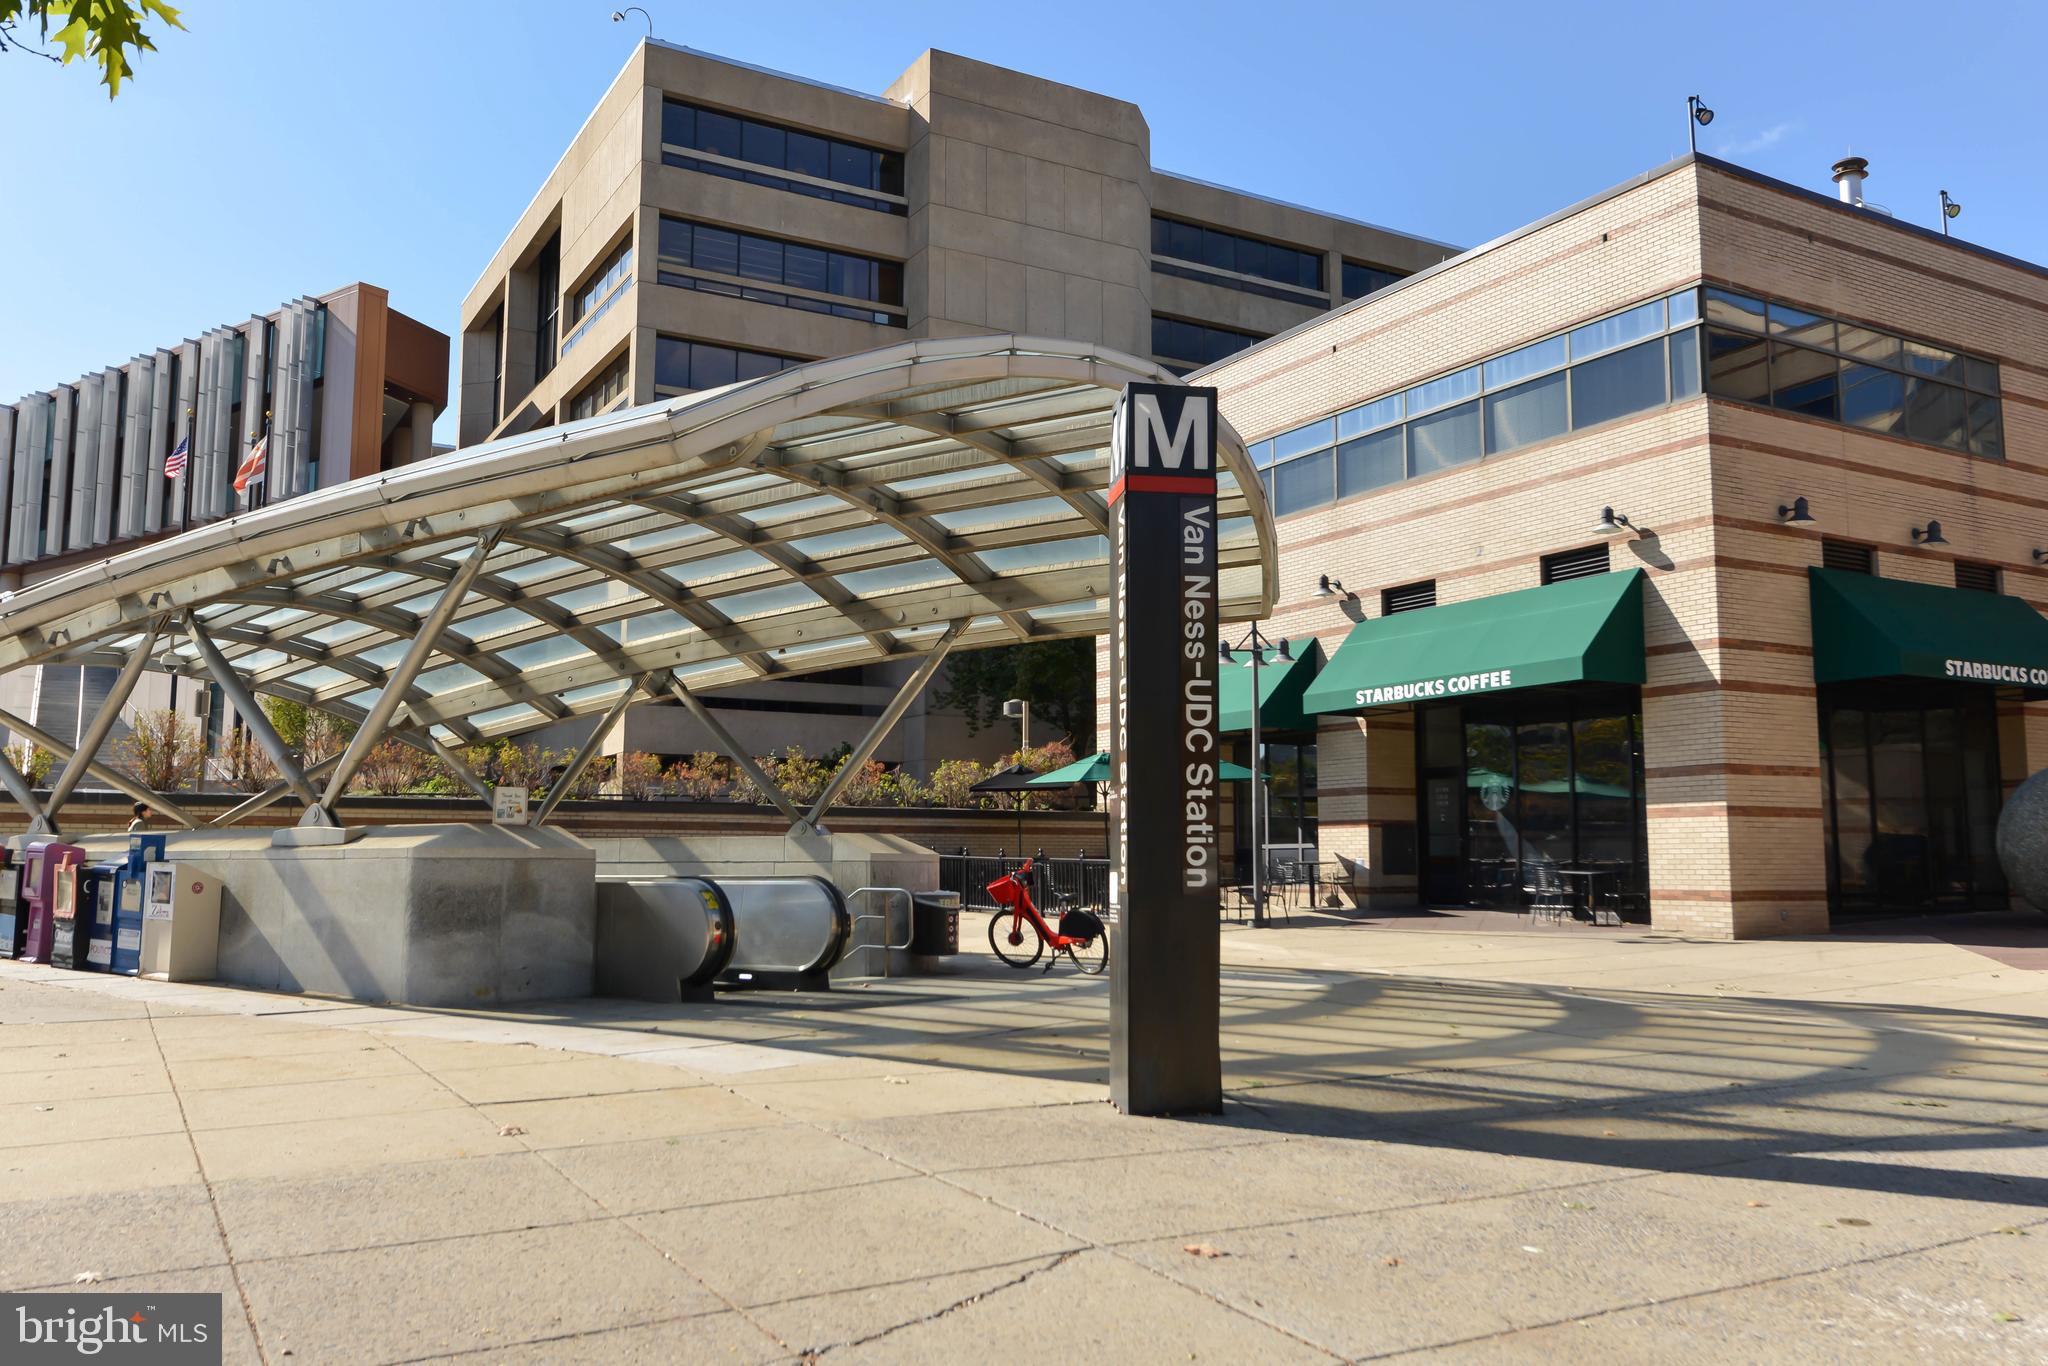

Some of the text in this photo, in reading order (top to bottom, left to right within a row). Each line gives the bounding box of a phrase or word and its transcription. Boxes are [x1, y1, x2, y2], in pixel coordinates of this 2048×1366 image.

[1134, 394, 1209, 470] M
[1184, 505, 1214, 888] Van Ness-UDC Station
[1355, 670, 1512, 705] STARBUCKS COFFEE
[1945, 659, 2048, 686] STARBUCKS CO
